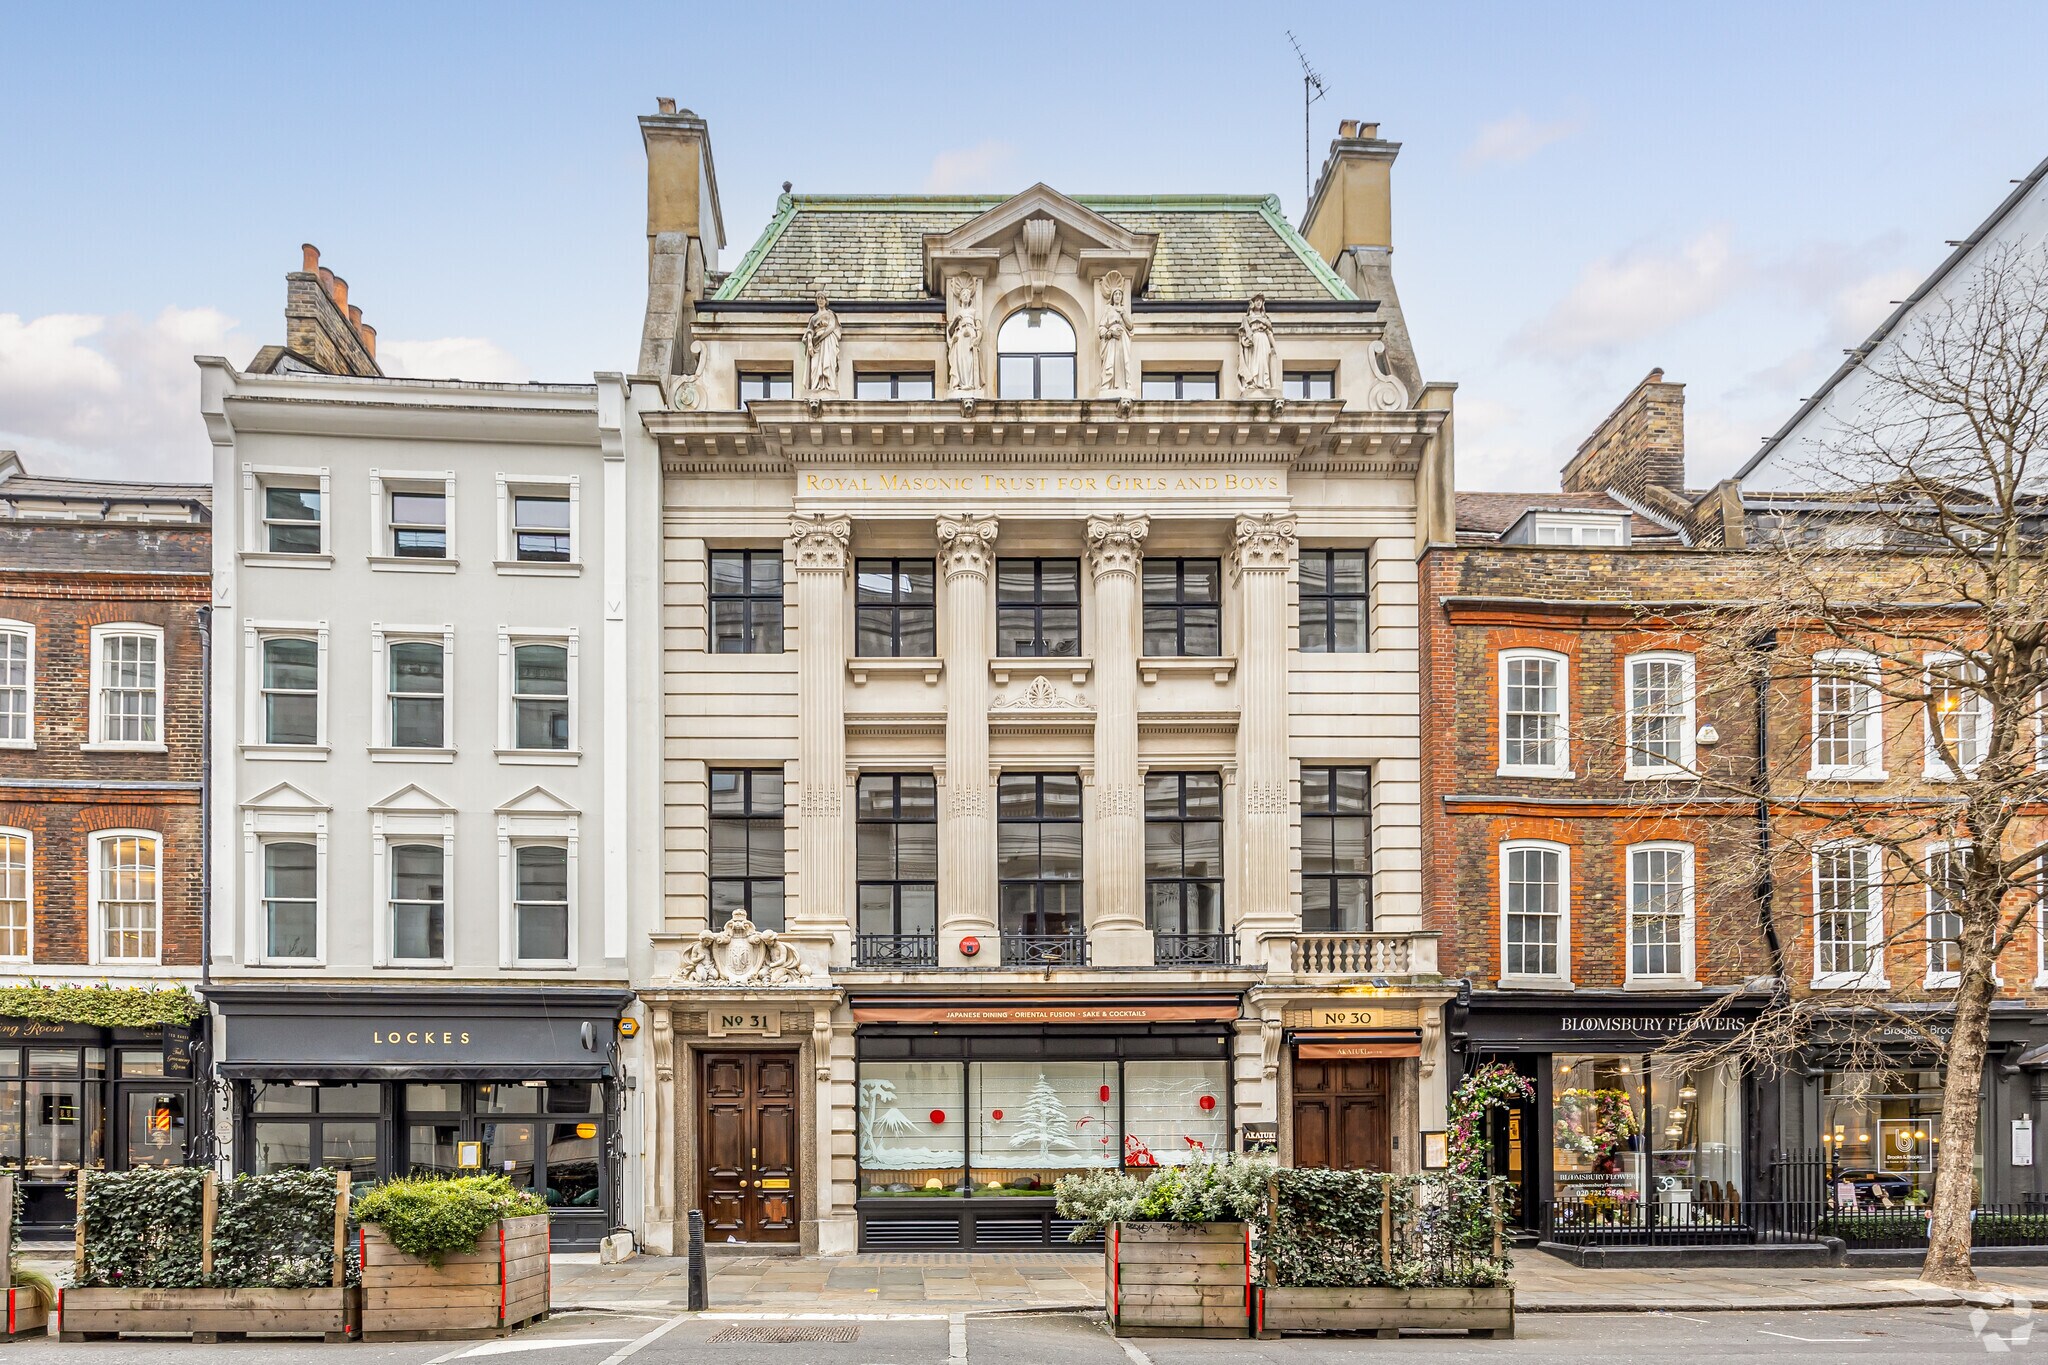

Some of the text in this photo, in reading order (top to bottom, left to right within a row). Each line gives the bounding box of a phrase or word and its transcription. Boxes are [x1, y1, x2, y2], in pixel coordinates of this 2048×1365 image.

[806, 473, 1278, 491] ROYAL MASONIC TRUST FOR GIRLS AND BOYS
[750, 1015, 768, 1027] 31
[1349, 1012, 1372, 1024] 30
[1561, 1017, 1745, 1031] BLOOMSBURY FLOWERS
[23, 1022, 65, 1036] Room
[1883, 1024, 1954, 1035] Brooks Broo
[374, 1032, 470, 1044] LOCKES
